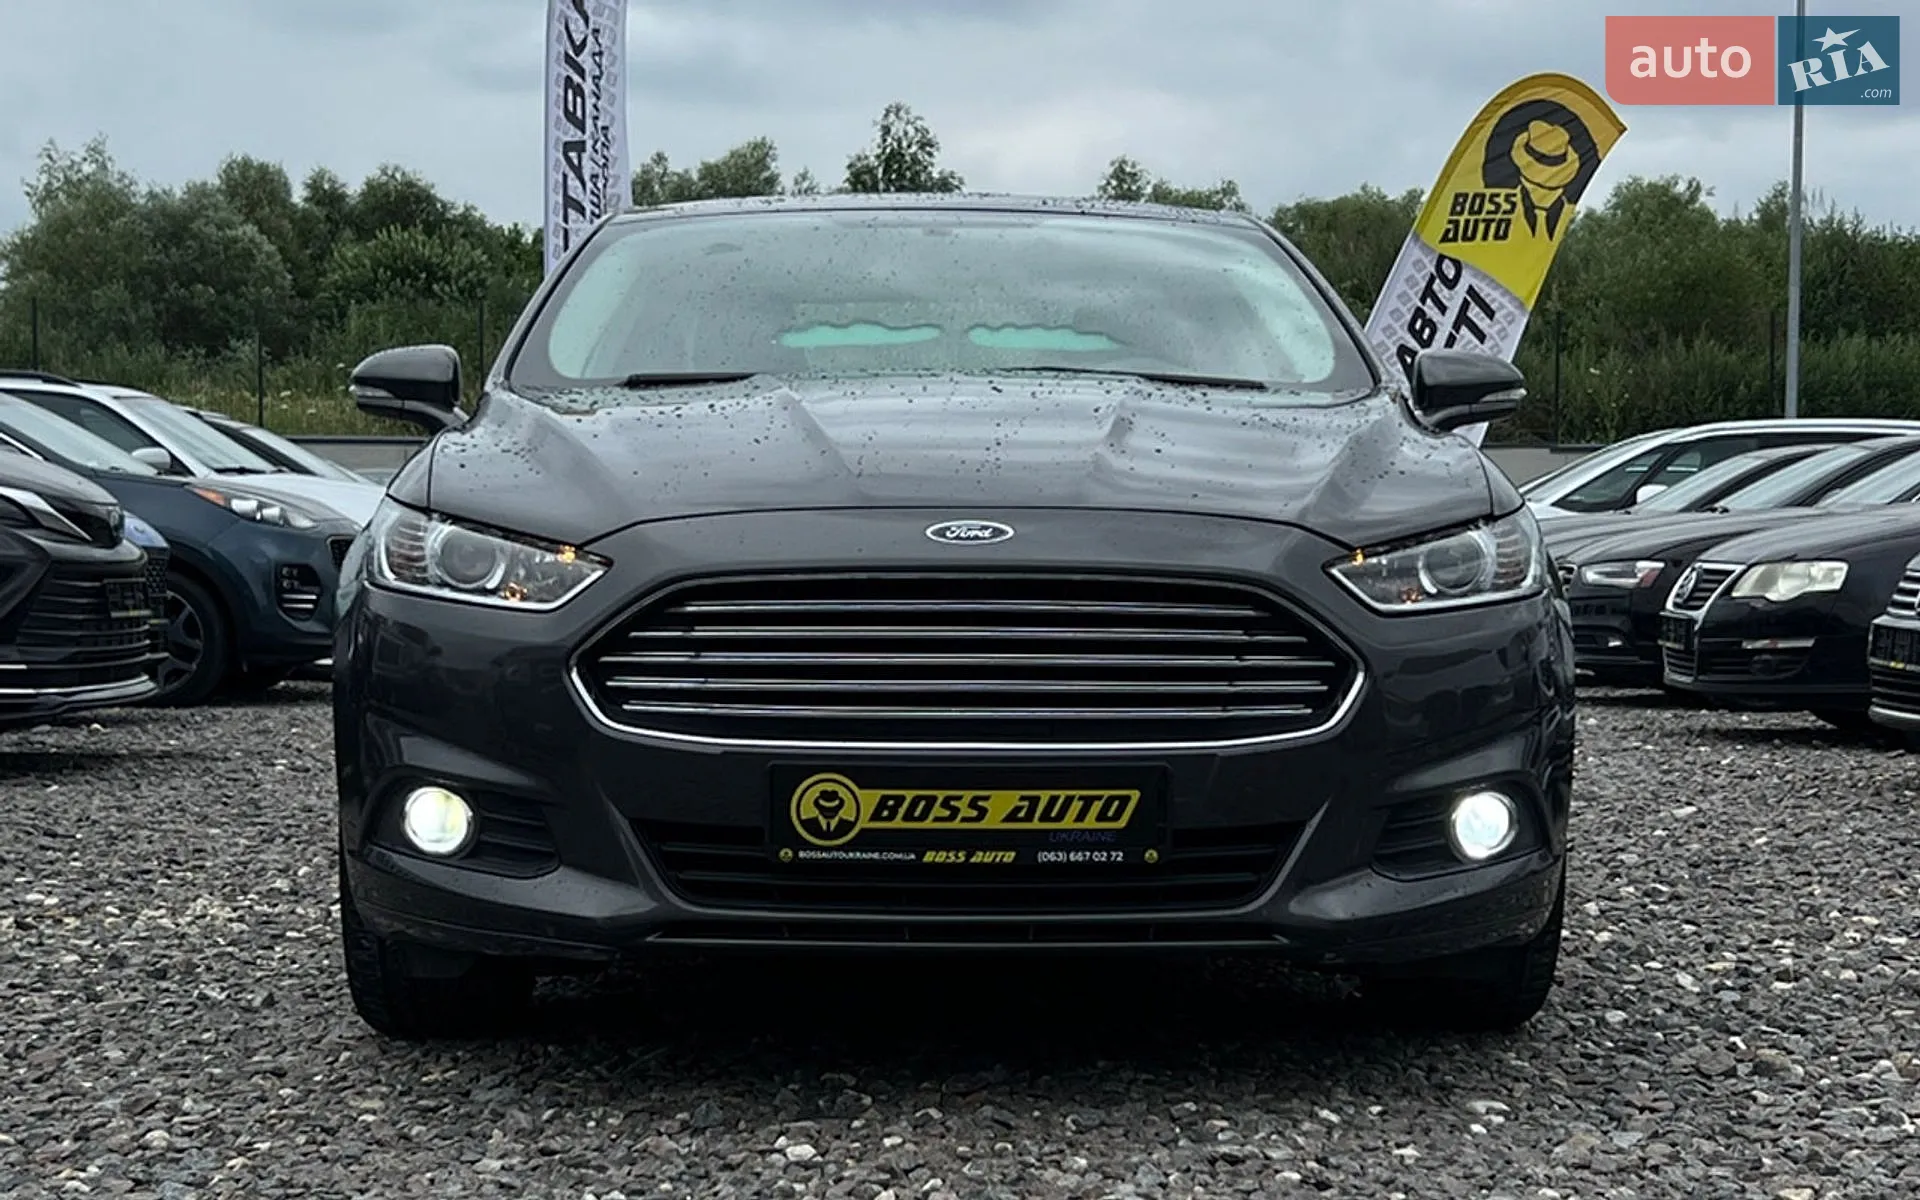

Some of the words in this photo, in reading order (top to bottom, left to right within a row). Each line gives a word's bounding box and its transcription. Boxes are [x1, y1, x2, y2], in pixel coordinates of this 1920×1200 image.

[1450, 192, 1517, 216] BOSS
[1439, 218, 1513, 244] AUTO
[945, 526, 993, 538] Ford
[868, 794, 990, 823] BOSS
[1002, 794, 1133, 823] AUTO
[1048, 832, 1117, 843] UKRAINE
[922, 851, 967, 863] BOSS
[970, 851, 1016, 863] AUTO
[1037, 850, 1068, 863] (063)
[1068, 851, 1092, 863] 667
[1093, 851, 1108, 863] 02
[1109, 851, 1124, 863] 72
